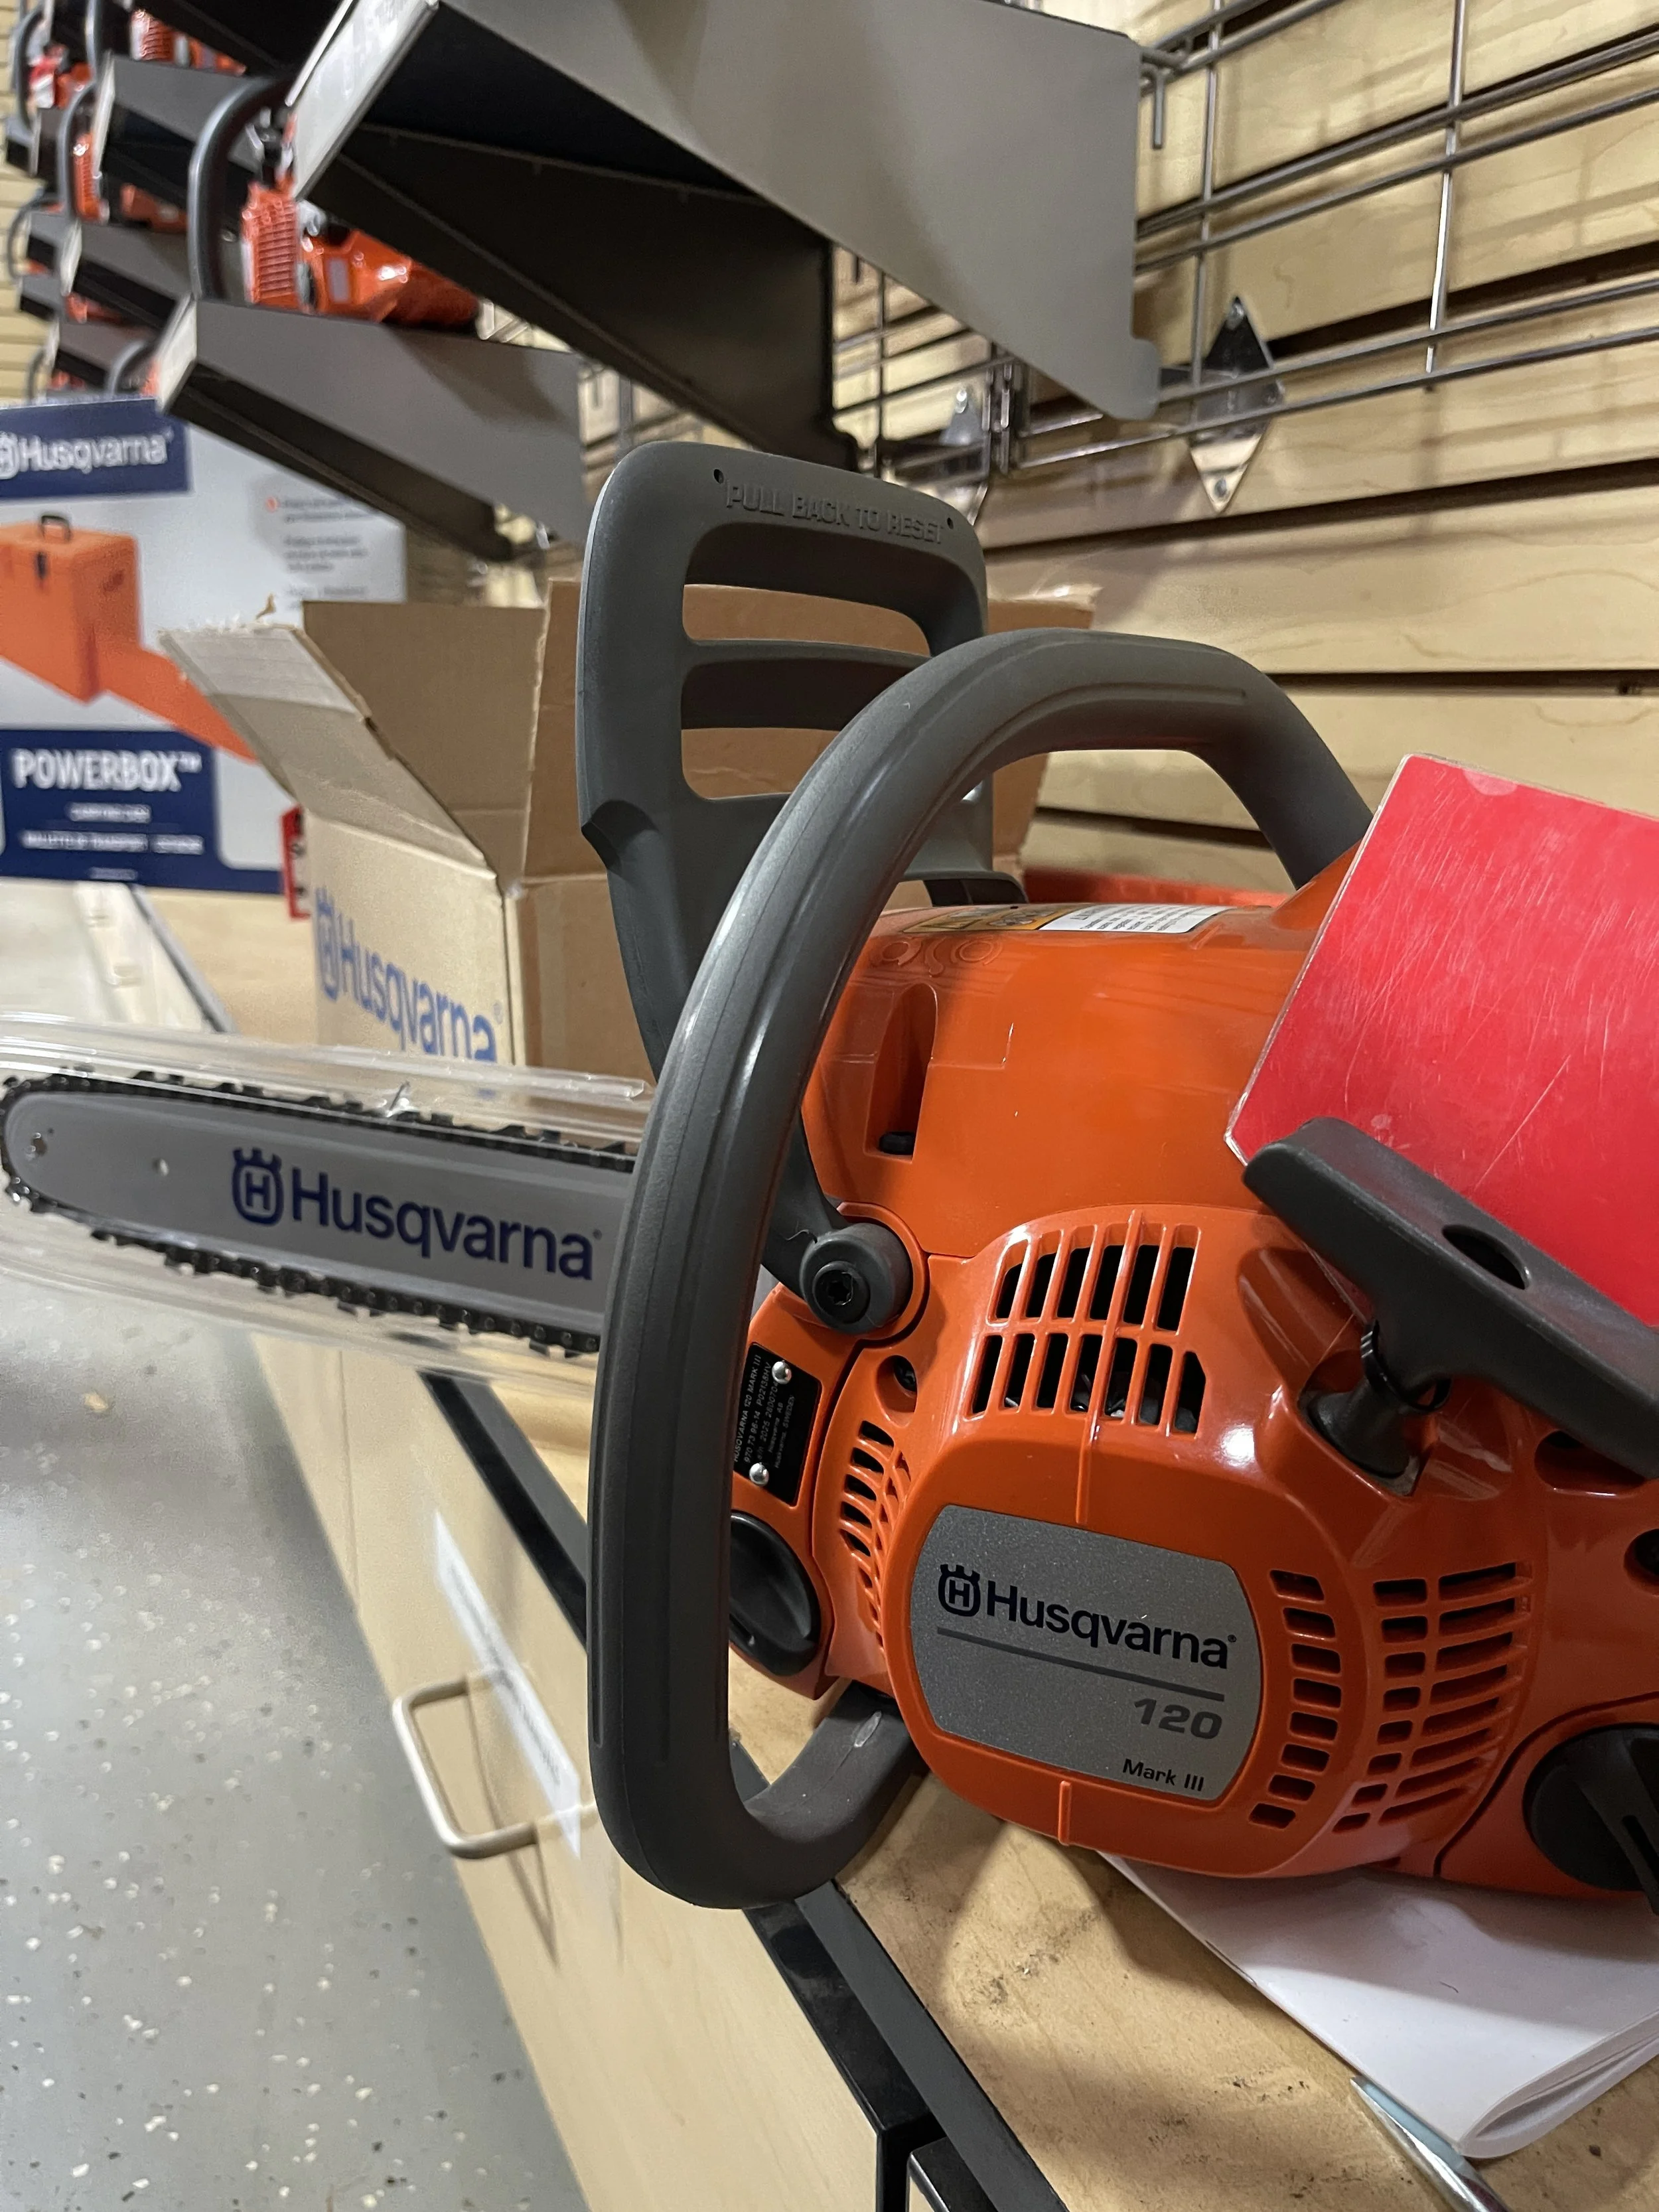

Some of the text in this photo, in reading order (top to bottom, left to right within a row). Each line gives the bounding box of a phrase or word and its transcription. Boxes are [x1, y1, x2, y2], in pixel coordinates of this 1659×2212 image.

[18, 433, 167, 473] Husqvarna
[726, 480, 944, 544] PULL BACK TO RESET
[339, 912, 496, 1062] Husqvarna
[291, 1166, 593, 1281] Husqvarna
[753, 1355, 762, 1366] III
[747, 1366, 758, 1393] MARK
[744, 1394, 753, 1407] 120
[744, 1447, 753, 1463] 970
[1133, 1698, 1222, 1739] 120
[1123, 1758, 1204, 1791] Mark III
